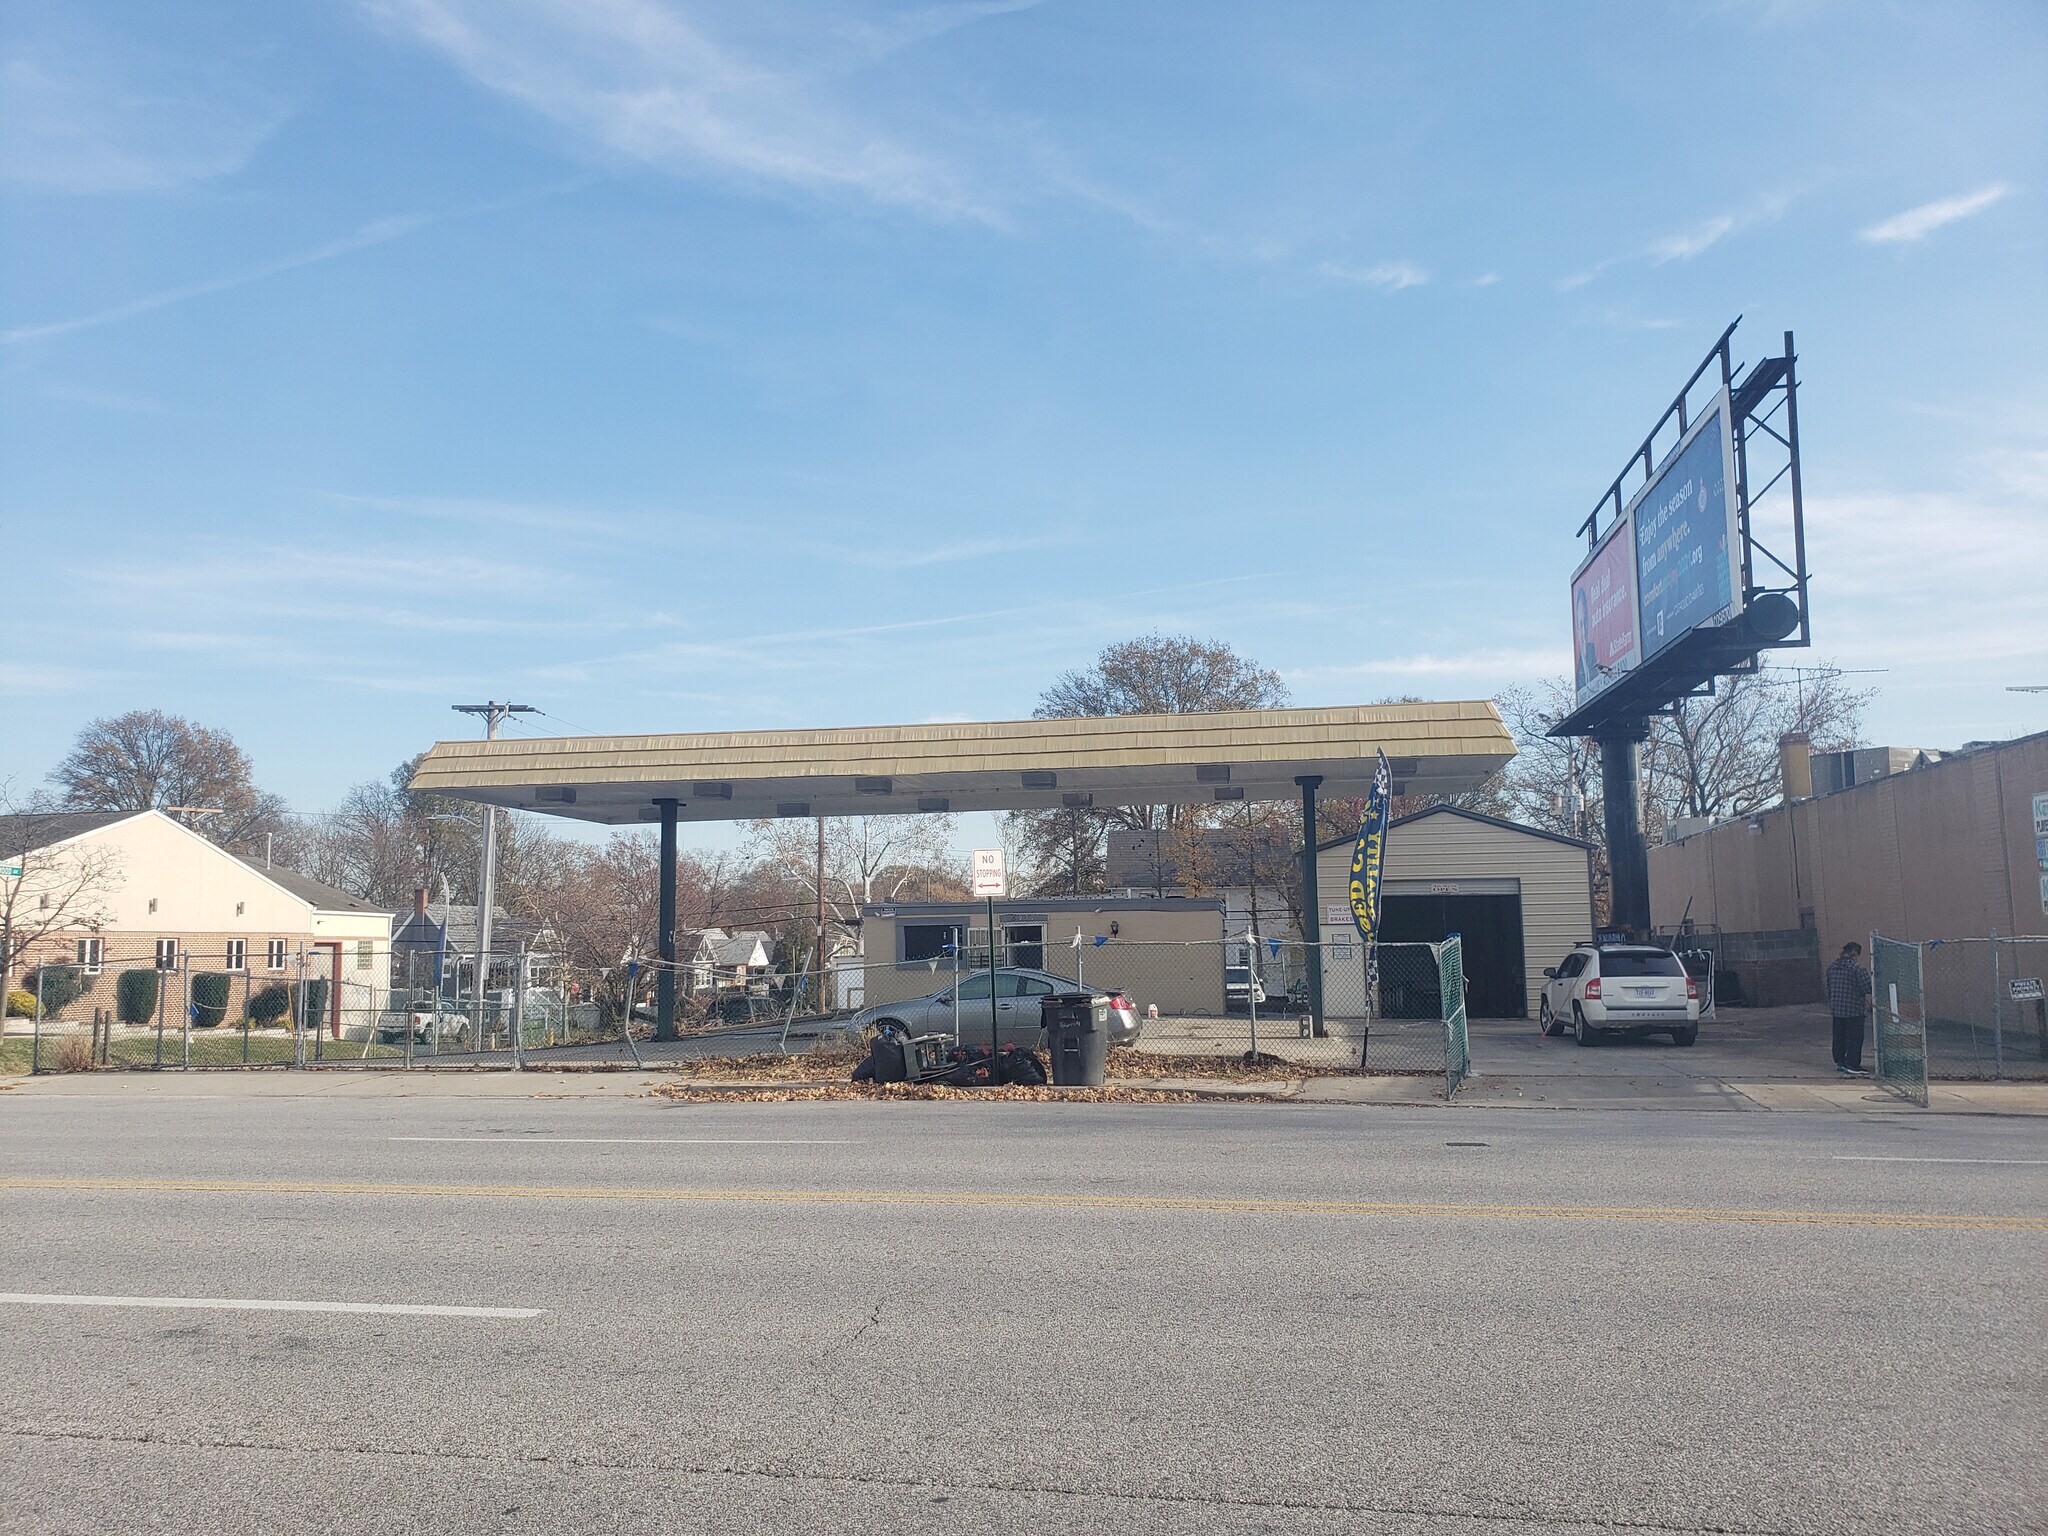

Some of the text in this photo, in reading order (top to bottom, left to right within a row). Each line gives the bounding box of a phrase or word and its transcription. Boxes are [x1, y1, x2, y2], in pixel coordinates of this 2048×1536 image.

[1640, 479, 1693, 547] Enjoy the season
[1642, 552, 1657, 577] from
[982, 855, 994, 863] NO
[976, 869, 1001, 877] STOPPING
